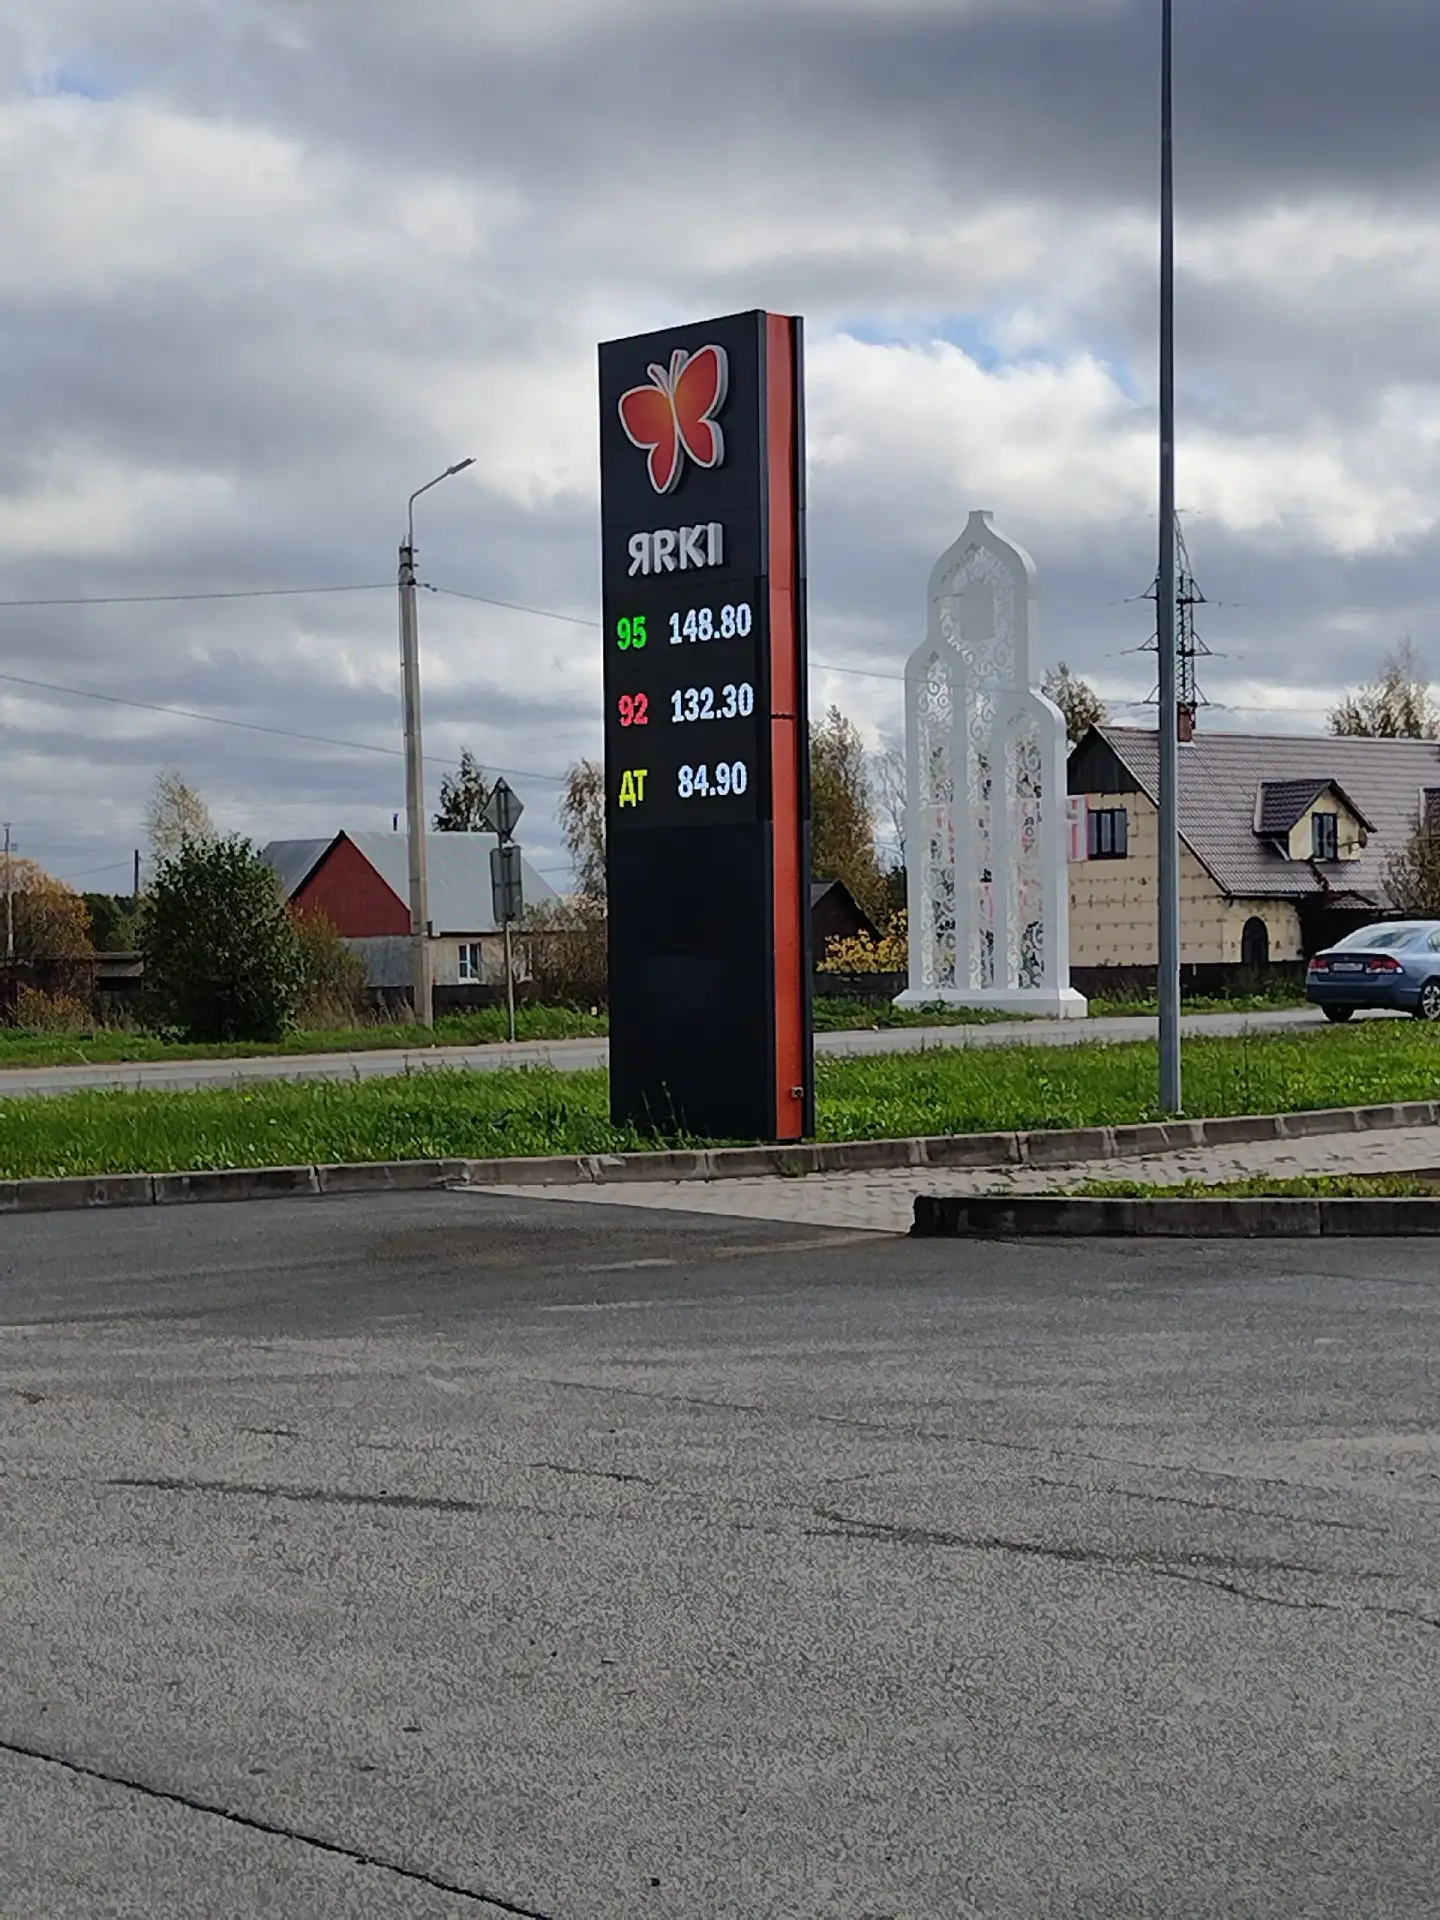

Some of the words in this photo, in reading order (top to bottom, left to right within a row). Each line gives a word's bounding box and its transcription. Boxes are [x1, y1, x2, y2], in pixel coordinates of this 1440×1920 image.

[617, 615, 646, 650] 95
[669, 602, 752, 644] 148.80
[618, 692, 648, 726] 92
[671, 682, 754, 723] 132.30
[618, 769, 648, 808] ДТ
[677, 761, 748, 798] 84.90
